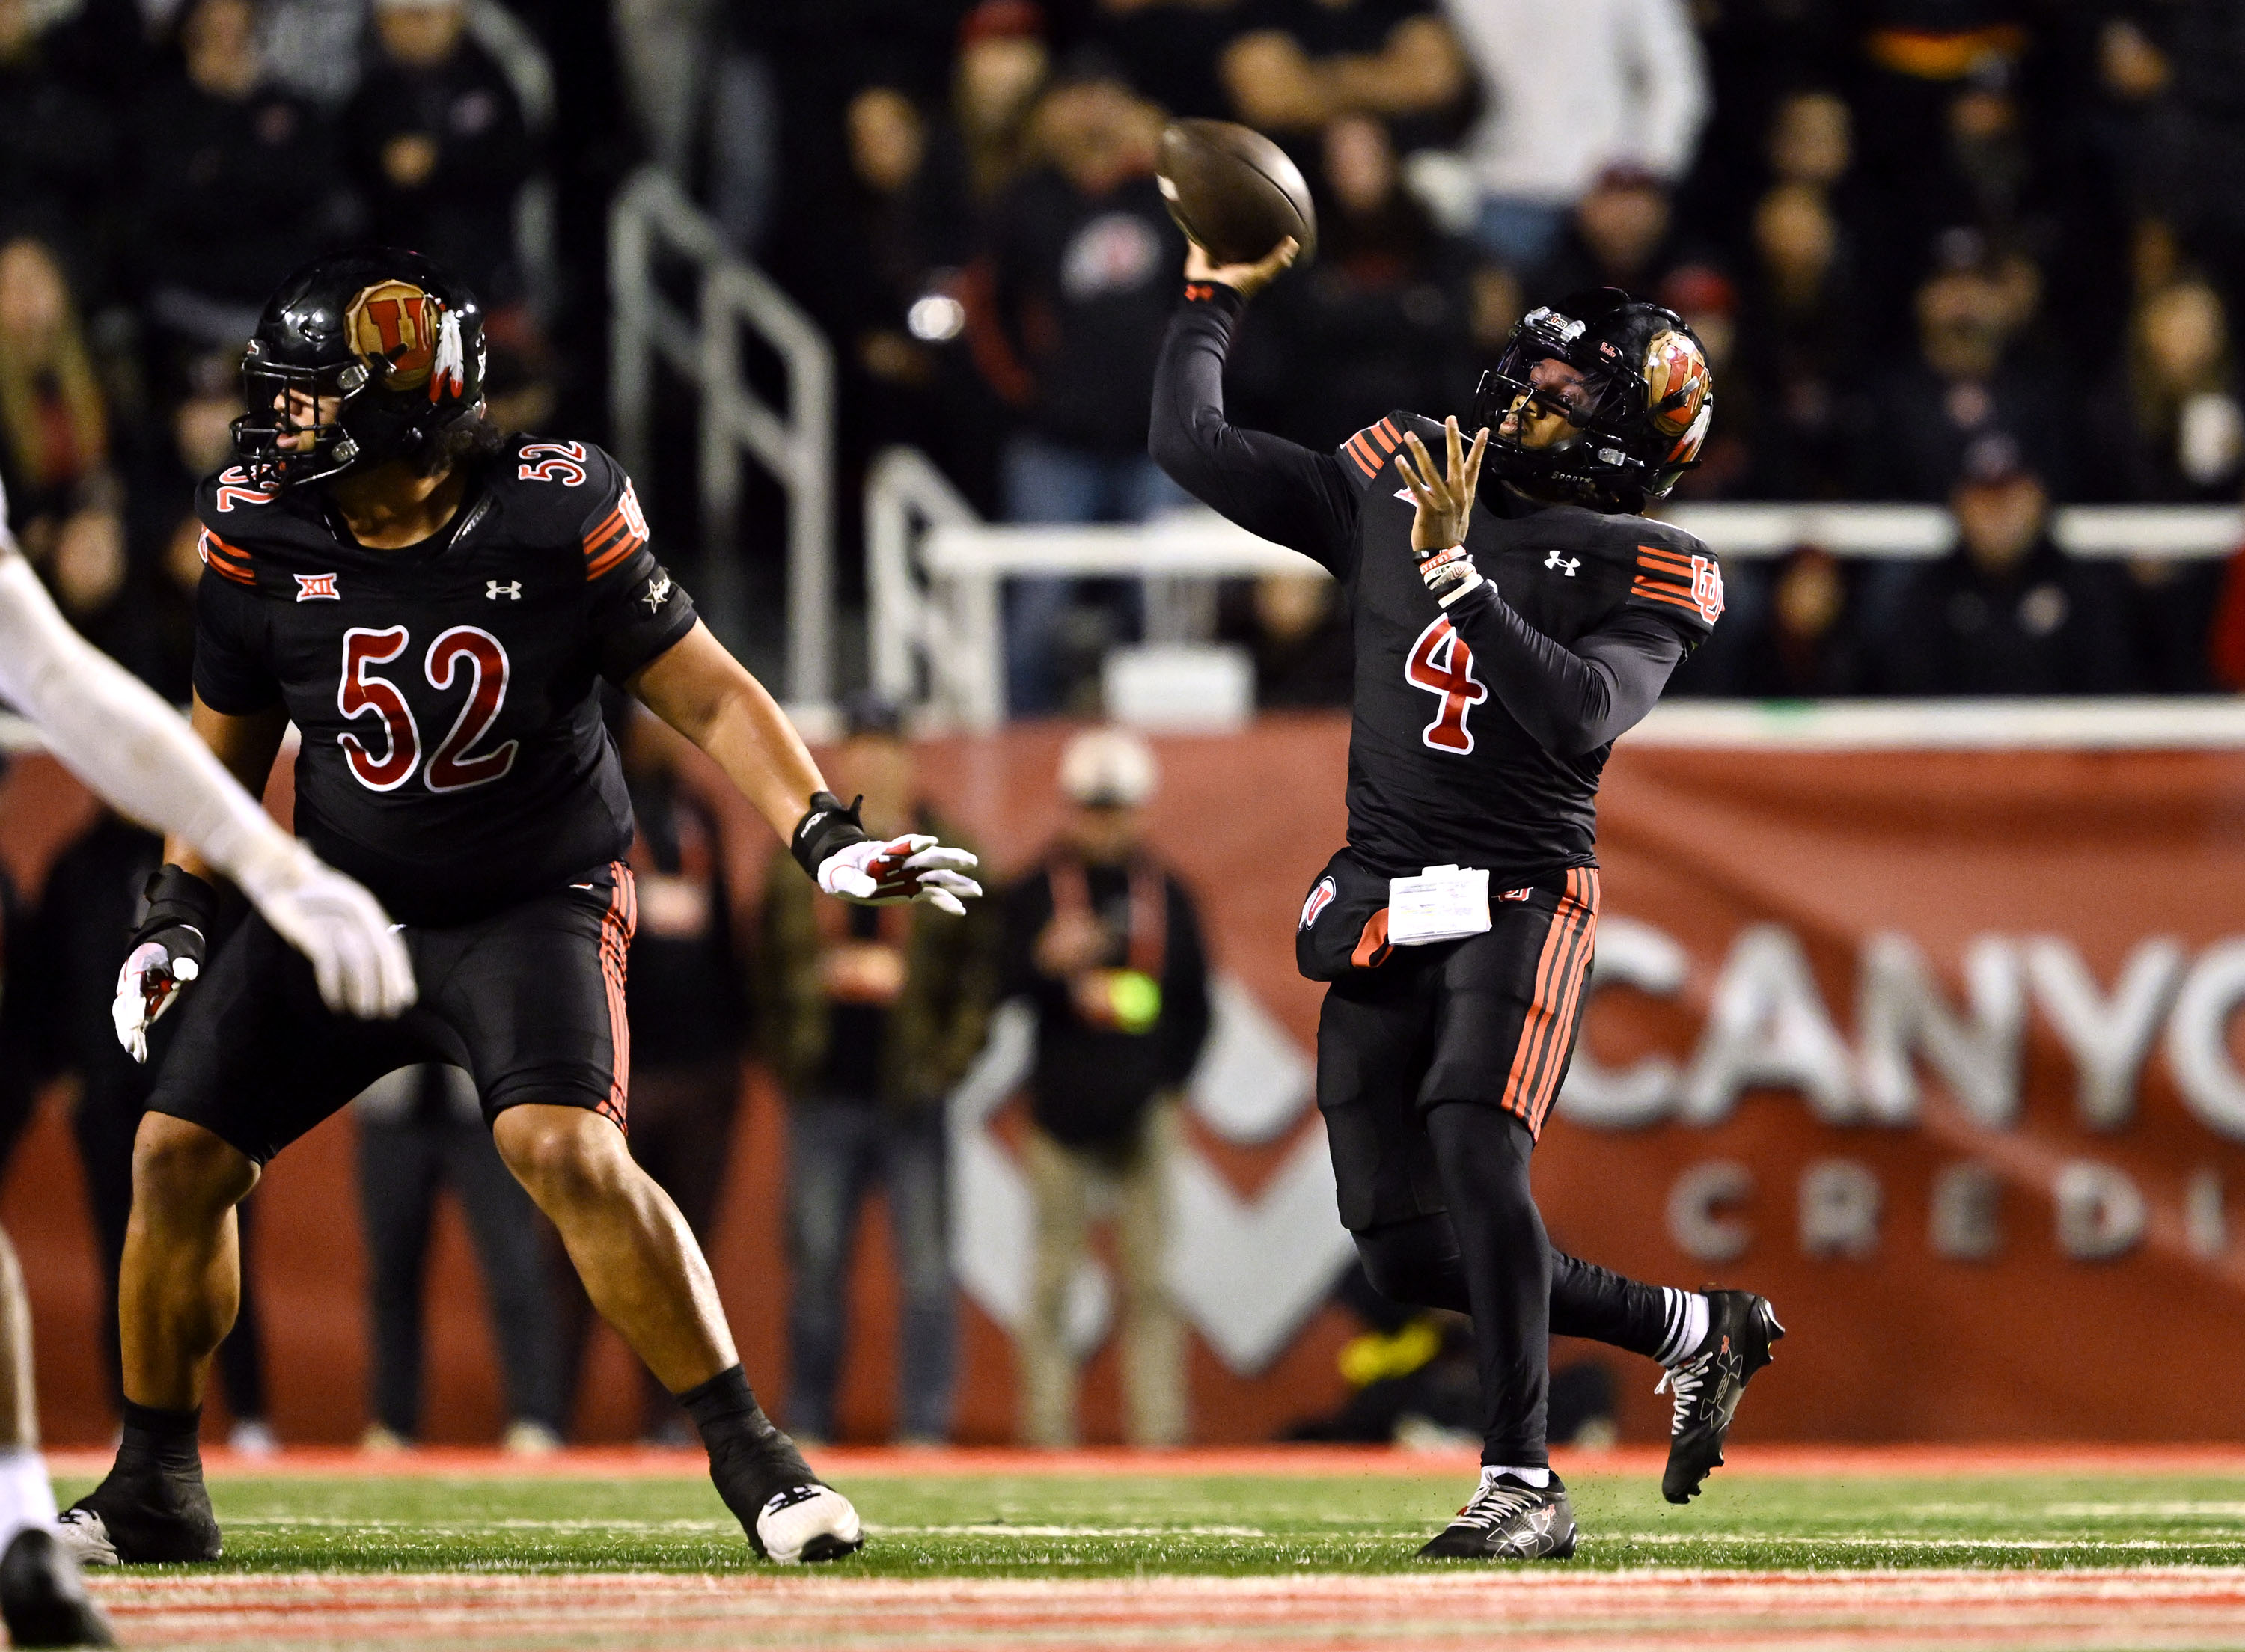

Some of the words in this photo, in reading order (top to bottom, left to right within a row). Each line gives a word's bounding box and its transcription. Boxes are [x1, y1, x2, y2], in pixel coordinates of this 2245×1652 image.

[519, 441, 586, 487] 52
[299, 575, 336, 597] XII
[337, 625, 519, 793] 52
[1405, 612, 1488, 755] 4
